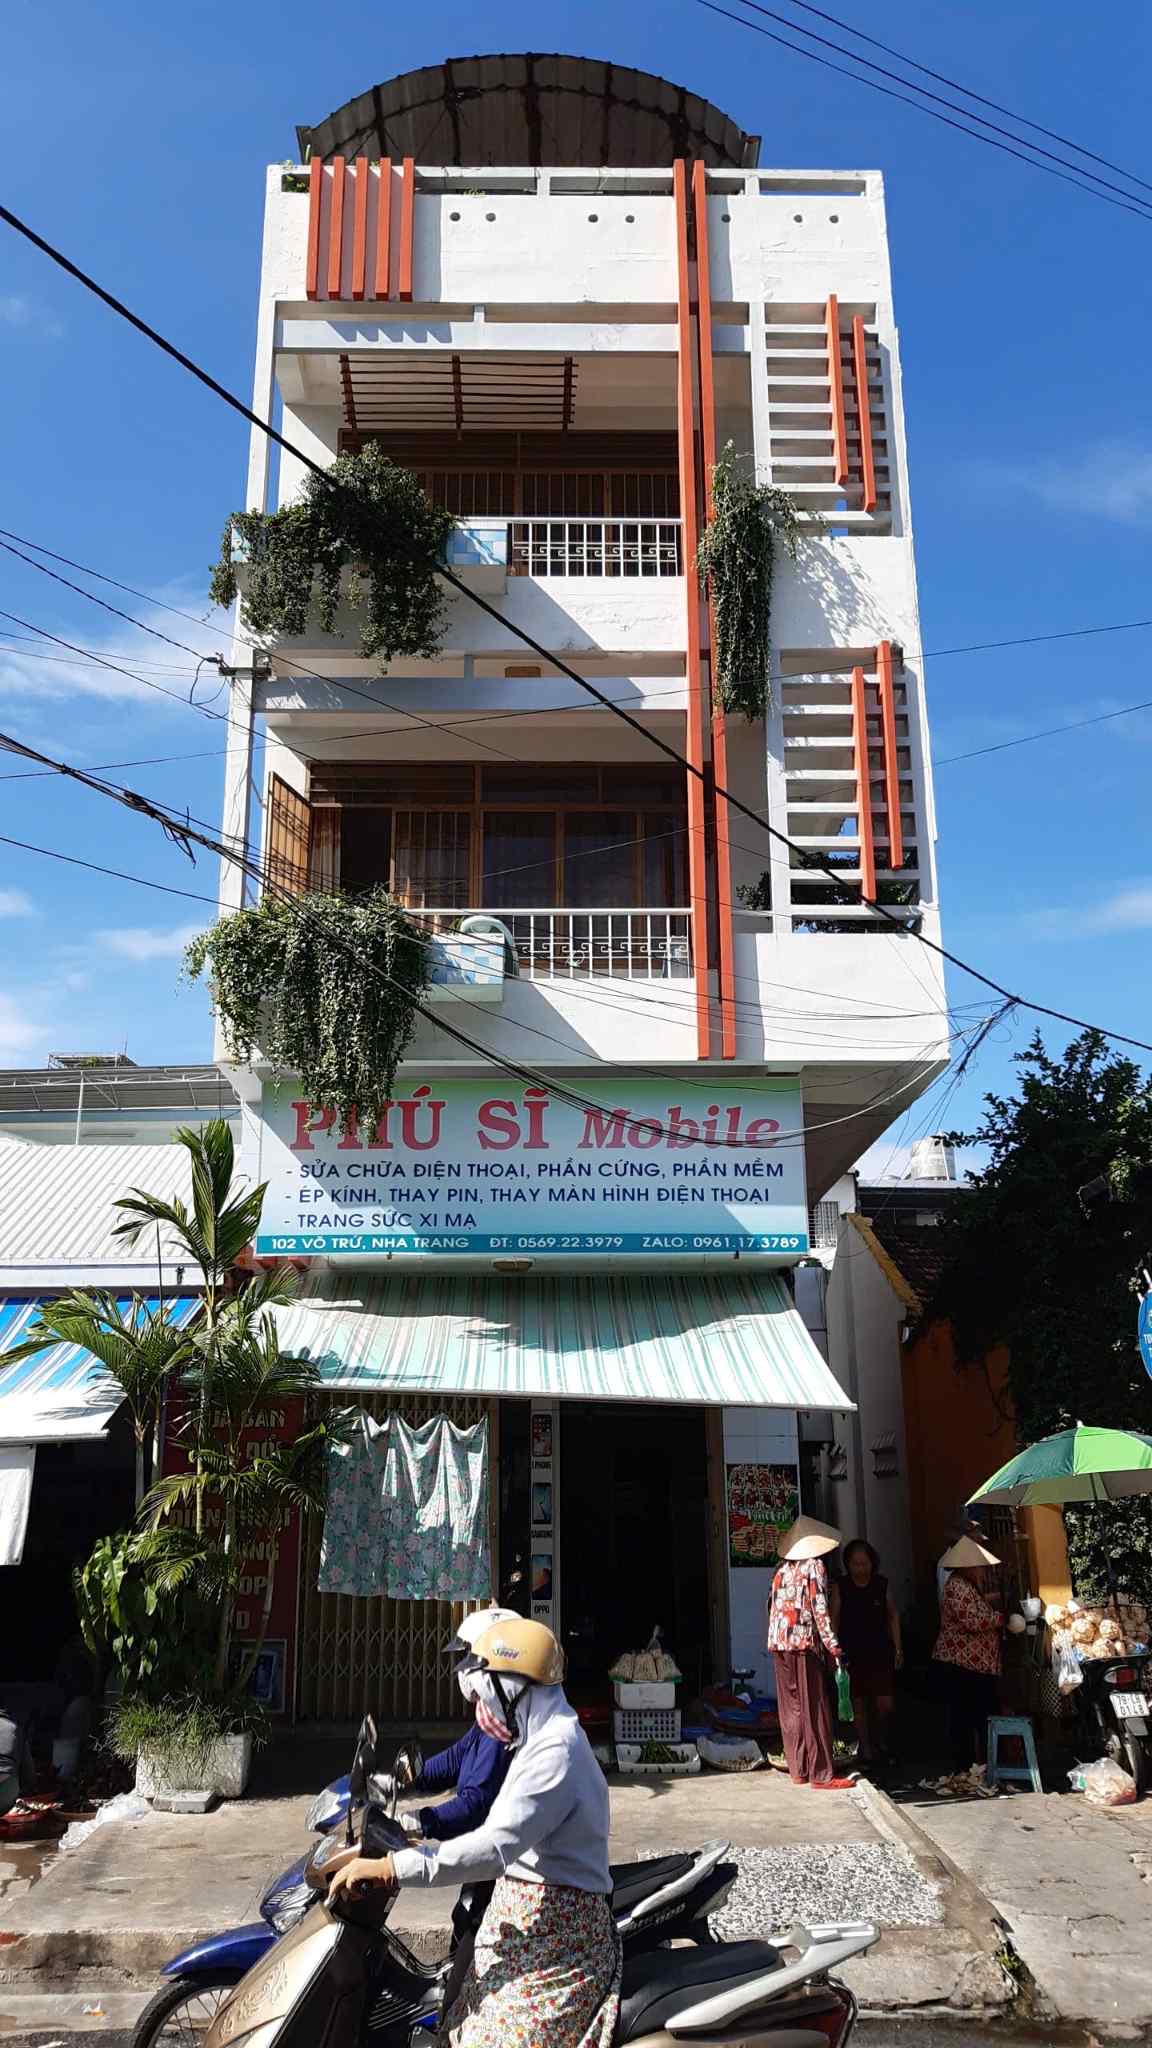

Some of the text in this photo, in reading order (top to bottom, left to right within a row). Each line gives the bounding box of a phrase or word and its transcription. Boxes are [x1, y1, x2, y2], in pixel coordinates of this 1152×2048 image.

[290, 1085, 447, 1151] PHÚ
[577, 1105, 781, 1149] Mobile
[299, 1158, 340, 1179] SỬA
[347, 1158, 406, 1179] CHỮA
[413, 1160, 461, 1181] ĐIỆN
[467, 1162, 531, 1181] THOẠI,
[537, 1157, 592, 1178] PHẦN
[598, 1159, 667, 1180] CỨNG,
[672, 1157, 727, 1178] PHẦN
[734, 1157, 784, 1178] MỀM
[331, 1185, 383, 1204] KÍNH,
[389, 1188, 444, 1203] THAY
[448, 1187, 484, 1204] PIN,
[491, 1187, 540, 1203] THAY
[548, 1184, 596, 1202] MÀN
[603, 1184, 649, 1202] HÌNH
[657, 1184, 705, 1204] ĐIỆN
[711, 1187, 769, 1205] THOẠI
[298, 1213, 365, 1228] TRANG
[371, 1209, 412, 1228] SỨC
[420, 1213, 438, 1227] XI
[445, 1213, 477, 1229] MẠ
[272, 1238, 297, 1249] 102
[372, 1238, 408, 1249] NHA
[413, 1237, 469, 1249] TRANG
[489, 1237, 513, 1249] ĐT:
[518, 1237, 624, 1248] 0569.22.3979
[642, 1237, 688, 1248] ZALO:
[694, 1237, 799, 1248] 0961.17.3789
